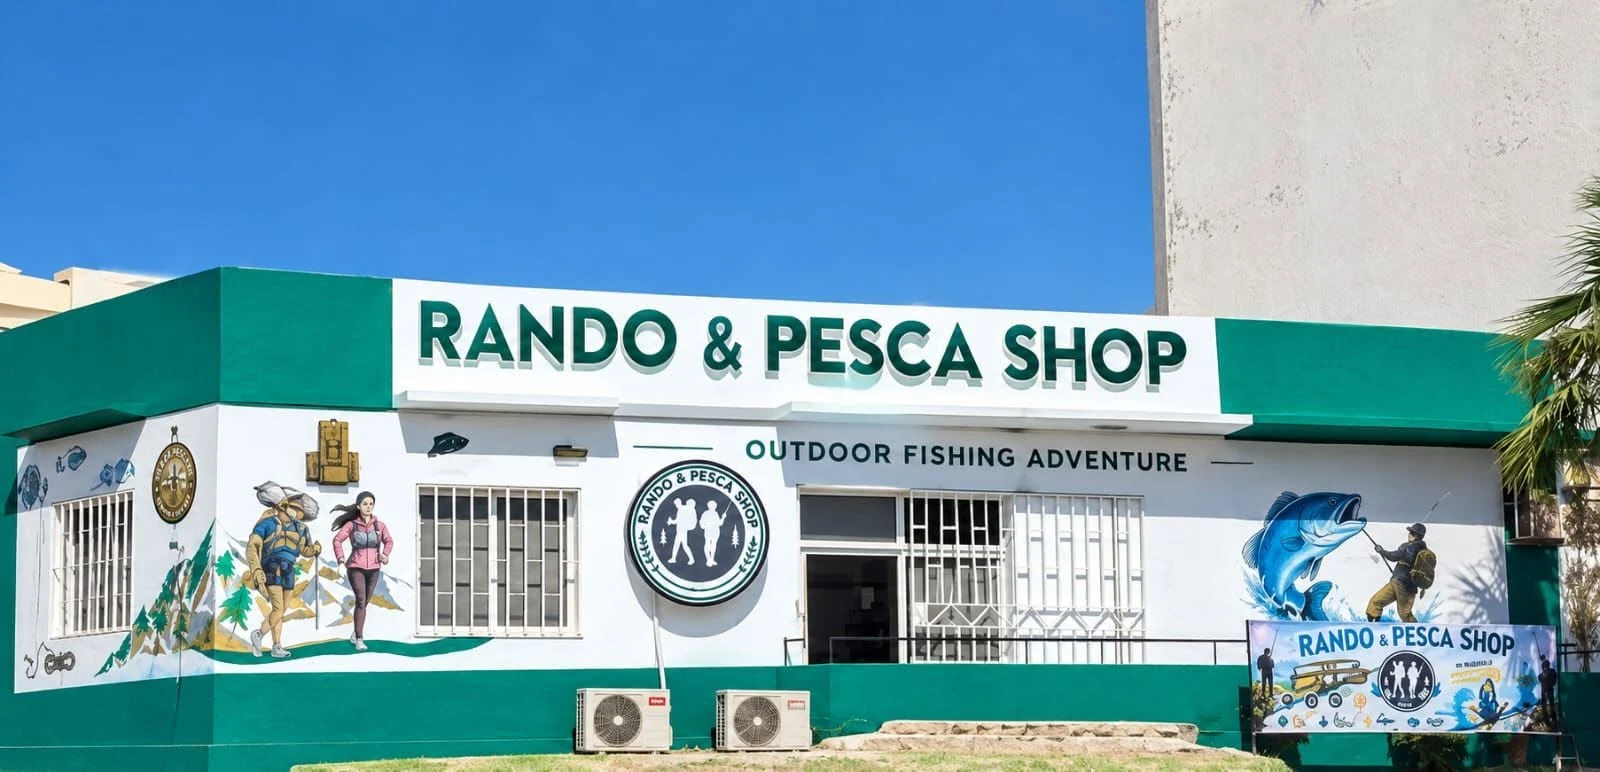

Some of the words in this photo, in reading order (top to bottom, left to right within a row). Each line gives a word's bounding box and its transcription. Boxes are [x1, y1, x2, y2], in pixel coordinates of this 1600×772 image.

[420, 299, 678, 368] RANDO
[703, 315, 742, 372] &
[767, 314, 983, 379] PESCA
[1004, 323, 1187, 385] SHOP
[745, 439, 891, 464] OUTDOOR
[904, 444, 1015, 468] FISHING
[1026, 449, 1188, 472] ADVENTURE
[637, 478, 673, 525] RANDO
[676, 472, 687, 484] &
[690, 470, 733, 494] PESCA
[734, 490, 759, 528] SHOP
[1298, 626, 1375, 658] RANDO
[1379, 633, 1389, 647] &
[1392, 625, 1455, 649] PESCA
[1460, 627, 1515, 657] SHOP
